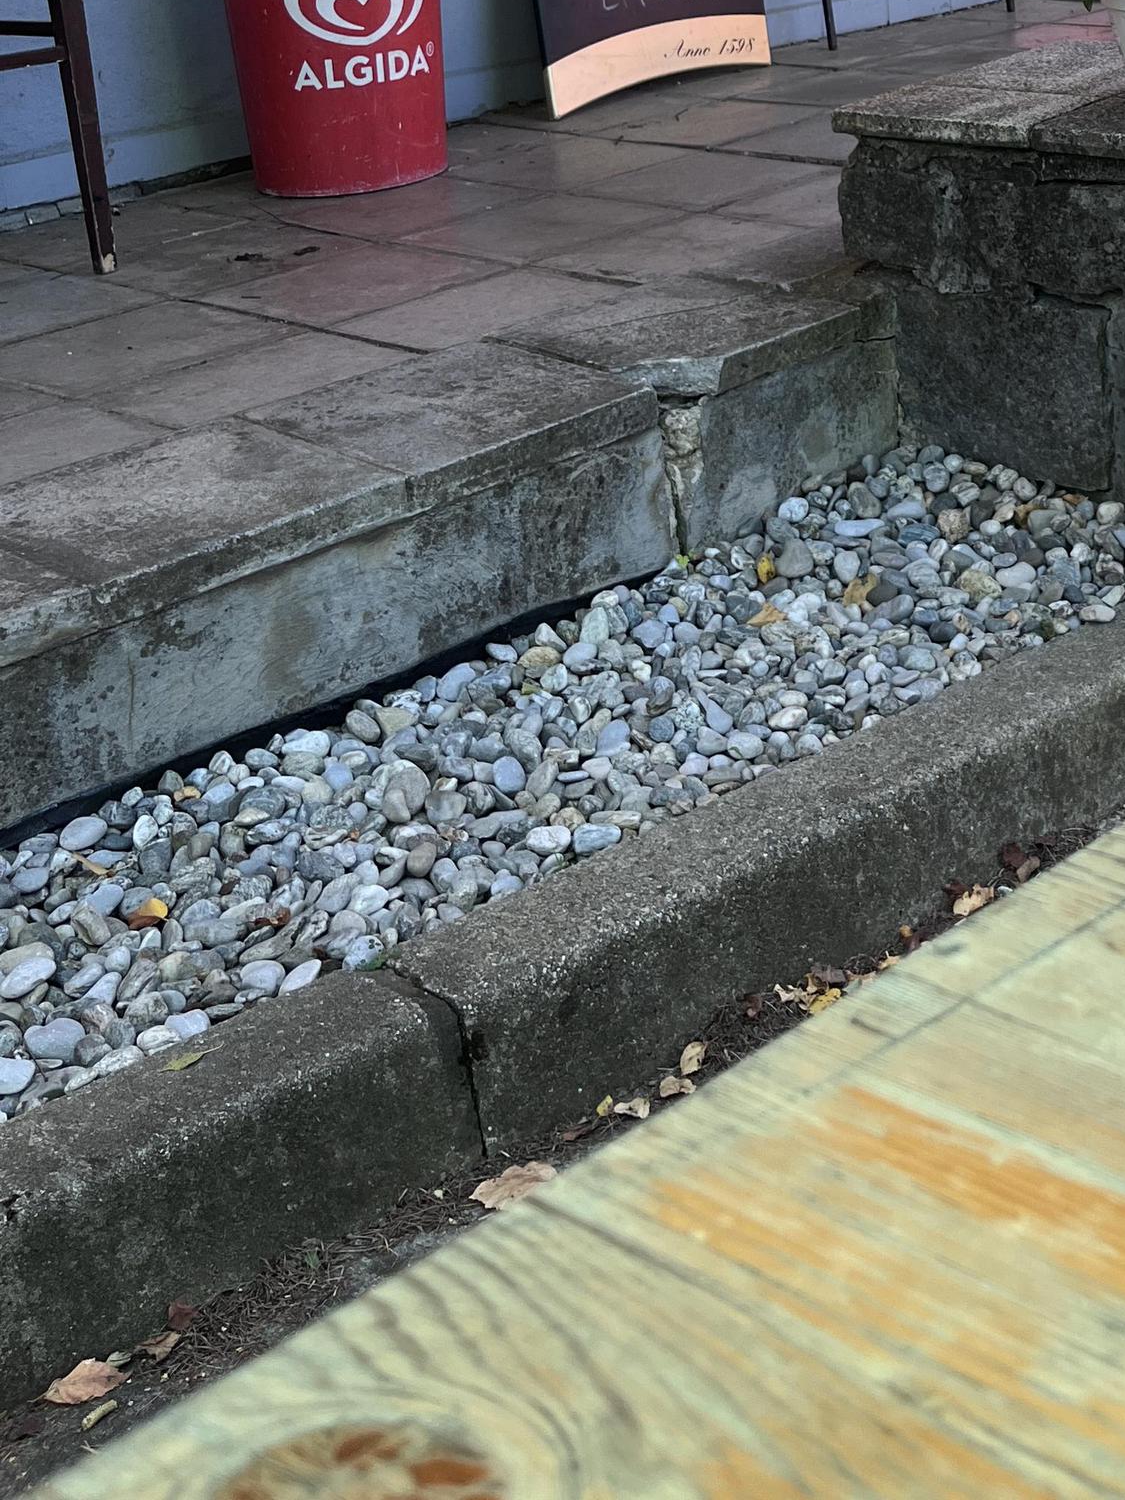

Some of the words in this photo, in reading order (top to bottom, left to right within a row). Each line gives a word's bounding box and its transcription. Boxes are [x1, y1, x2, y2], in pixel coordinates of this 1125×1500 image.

[664, 38, 711, 58] Anno
[718, 37, 755, 55] 1598
[294, 44, 430, 92] ALGIDA
